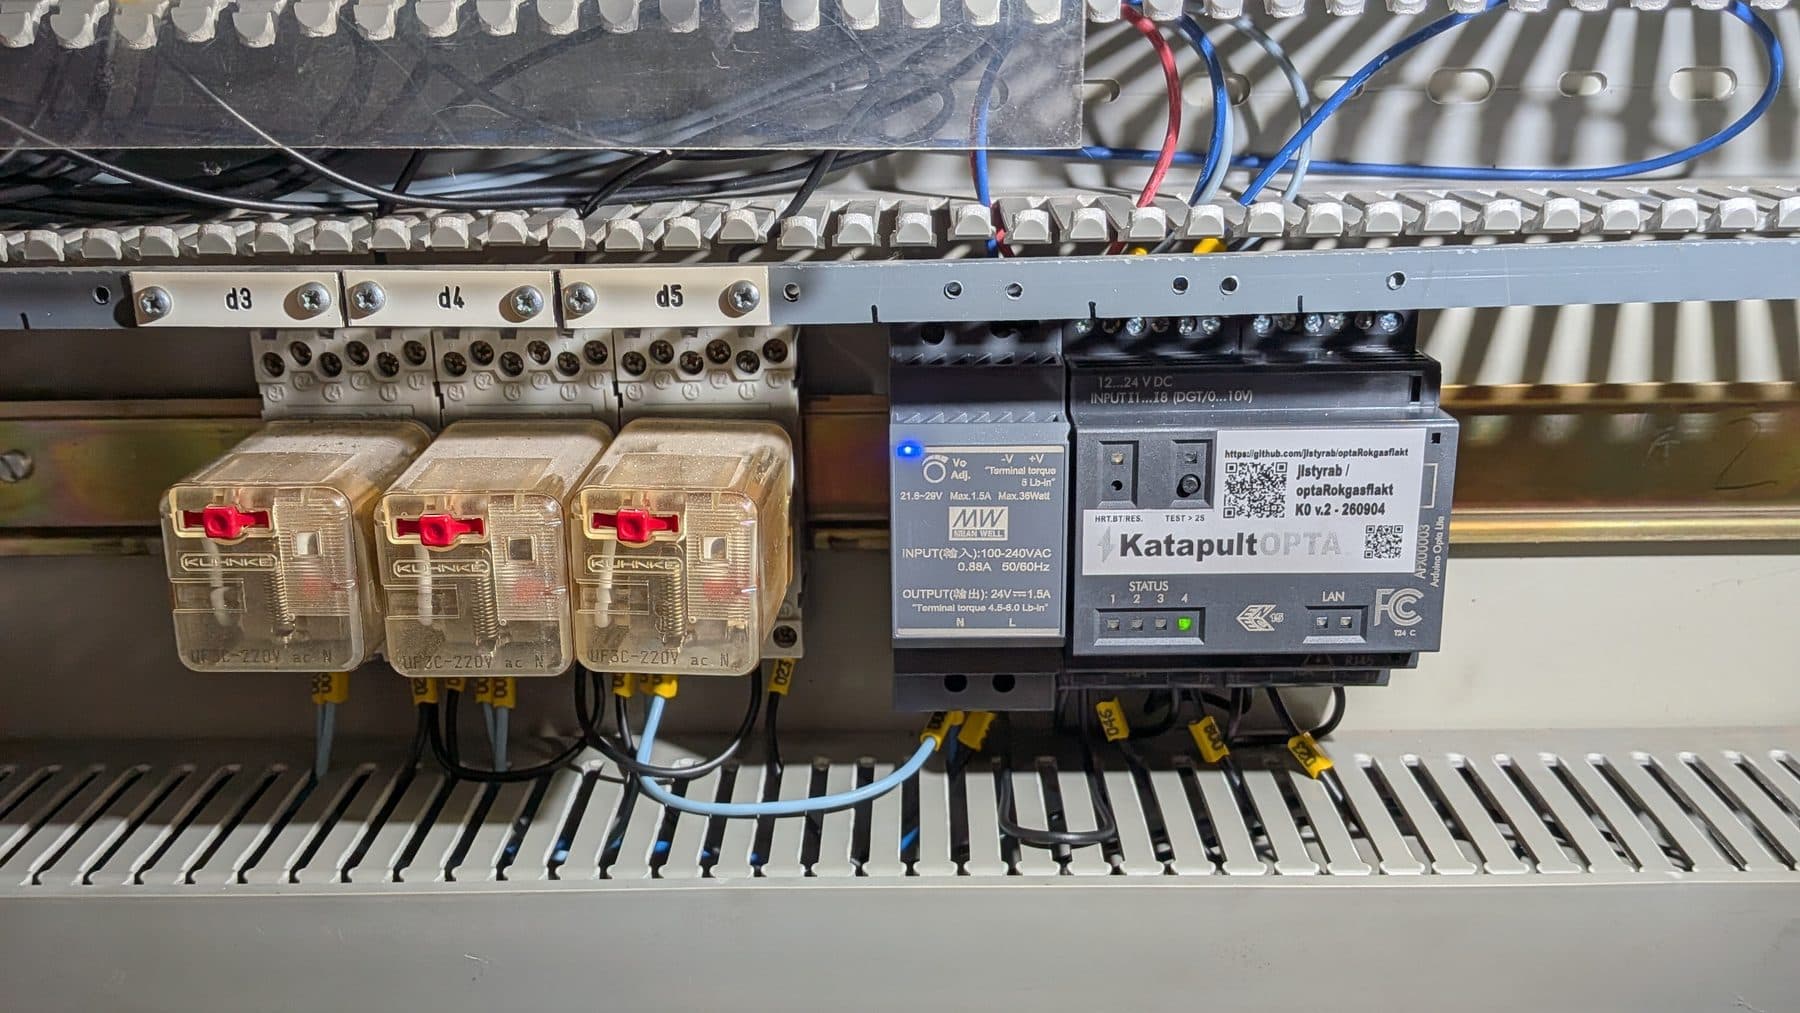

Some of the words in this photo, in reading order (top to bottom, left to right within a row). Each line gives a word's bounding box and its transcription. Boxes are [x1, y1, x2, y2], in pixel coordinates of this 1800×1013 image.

[225, 286, 252, 311] d3
[438, 285, 465, 309] d4
[657, 284, 684, 307] d5
[1098, 376, 1139, 389] 12...24
[1142, 376, 1151, 388] V
[1153, 375, 1174, 387] DC
[1173, 390, 1253, 405] (DGT/0...10V)
[952, 458, 967, 467] Vo
[1029, 454, 1044, 464] +V
[951, 470, 971, 481] Adj.
[1028, 466, 1056, 477] torque
[1296, 483, 1394, 499] optaRokgasflakt
[1315, 503, 1331, 516] v.2
[1342, 502, 1385, 516] 260904
[952, 508, 1004, 528] MW
[1165, 514, 1186, 522] TEST
[1433, 532, 1444, 554] Opta
[957, 562, 992, 572] 0.88A
[1001, 562, 1050, 572] 50/60Hz
[1430, 555, 1441, 588] Arduino
[1129, 580, 1169, 592] STATUS
[1110, 594, 1116, 604] 1
[1133, 594, 1141, 604] 2
[1157, 593, 1164, 603] 3
[1181, 593, 1188, 603] 4
[1322, 591, 1345, 602] LAN
[957, 604, 986, 613] torque
[956, 617, 965, 627] N
[1009, 618, 1017, 627] L
[505, 658, 523, 668] ac
[690, 656, 708, 666] ac
[720, 652, 729, 666] N
